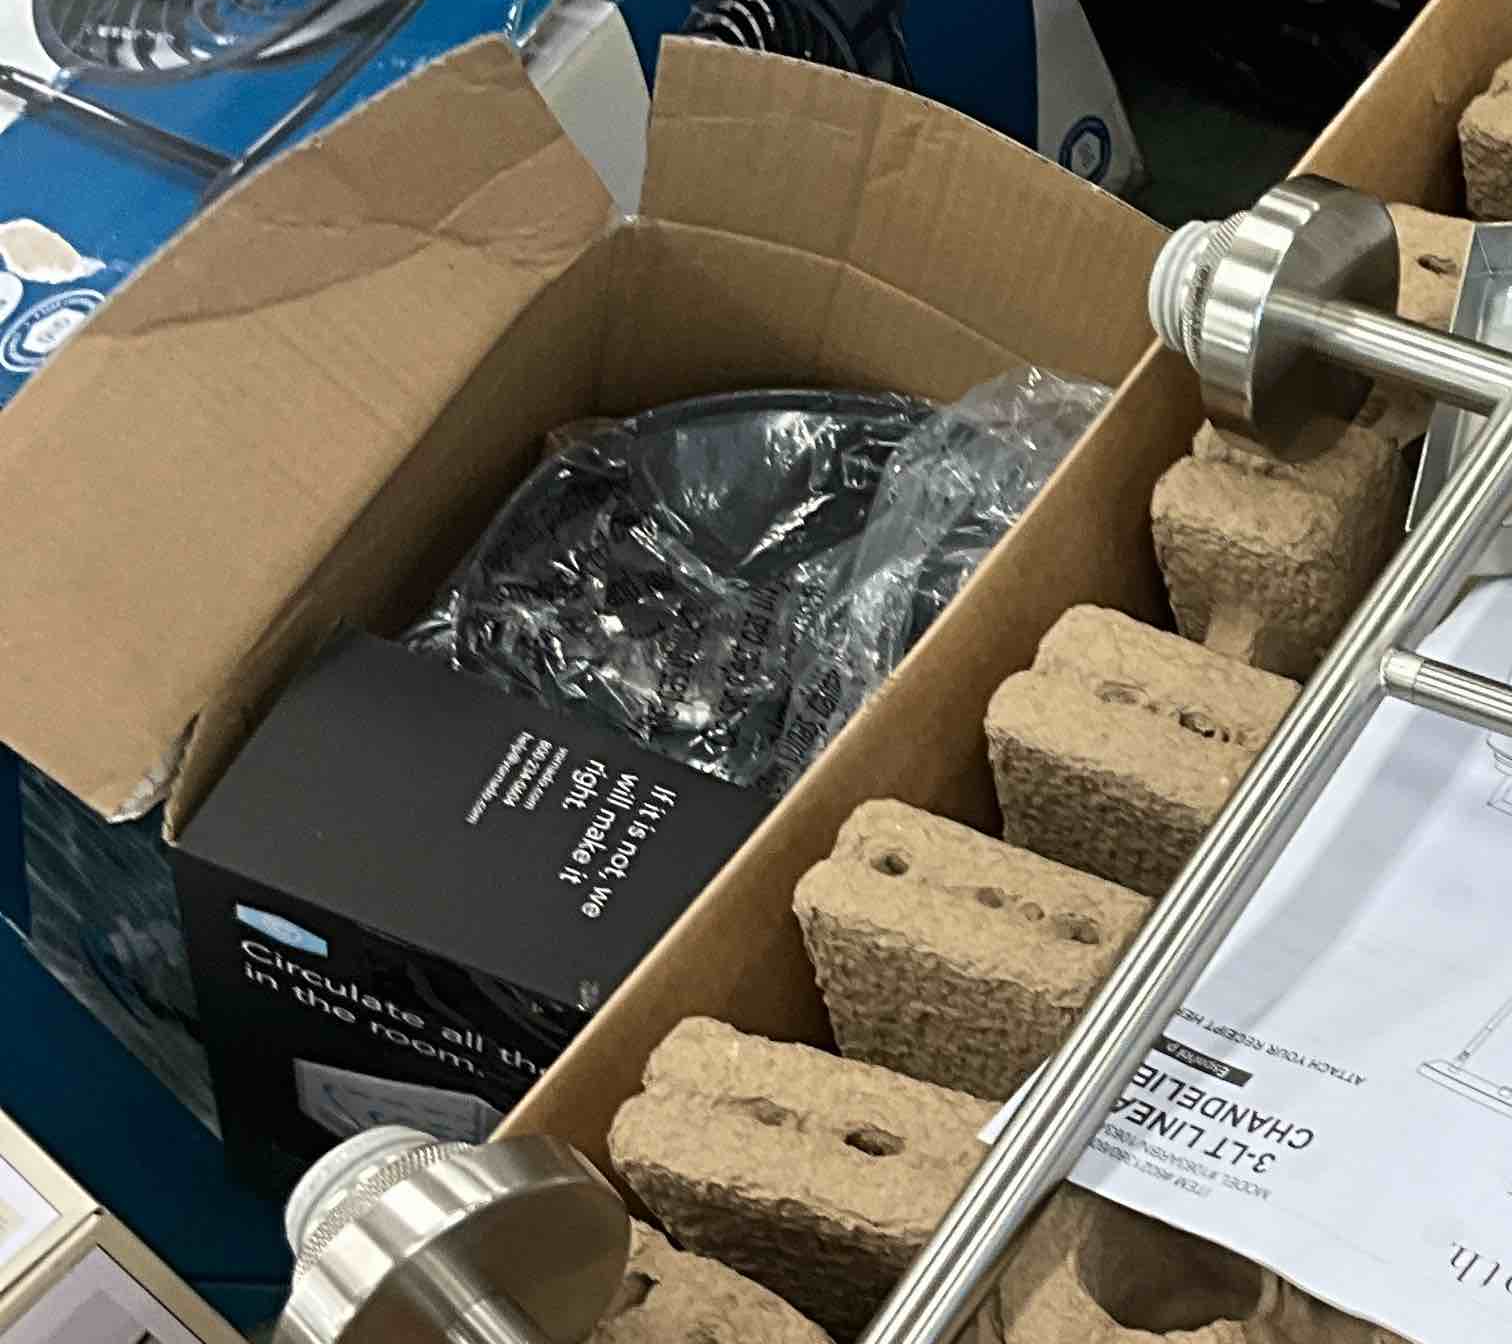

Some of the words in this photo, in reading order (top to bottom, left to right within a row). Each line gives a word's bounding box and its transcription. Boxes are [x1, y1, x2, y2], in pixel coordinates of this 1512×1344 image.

[606, 773, 639, 810] will
[650, 784, 677, 807] If
[638, 802, 667, 820] it
[571, 807, 616, 865] make
[627, 819, 657, 839] is
[558, 866, 589, 885] it
[597, 840, 638, 880] not,
[581, 886, 612, 918] we
[241, 940, 424, 1028] Circulate
[441, 1026, 483, 1053] all
[500, 1048, 546, 1076] th
[246, 961, 278, 991] in
[292, 985, 356, 1024] the
[370, 1021, 485, 1077] room.
[1202, 1020, 1264, 1051] RECEIPT
[1265, 1043, 1305, 1066] YOUR
[1307, 1058, 1367, 1086] ATTACH
[1108, 1092, 1206, 1149] LINEA
[1128, 1061, 1315, 1150] CHANDELIE
[1203, 1136, 1276, 1174] 3-LT
